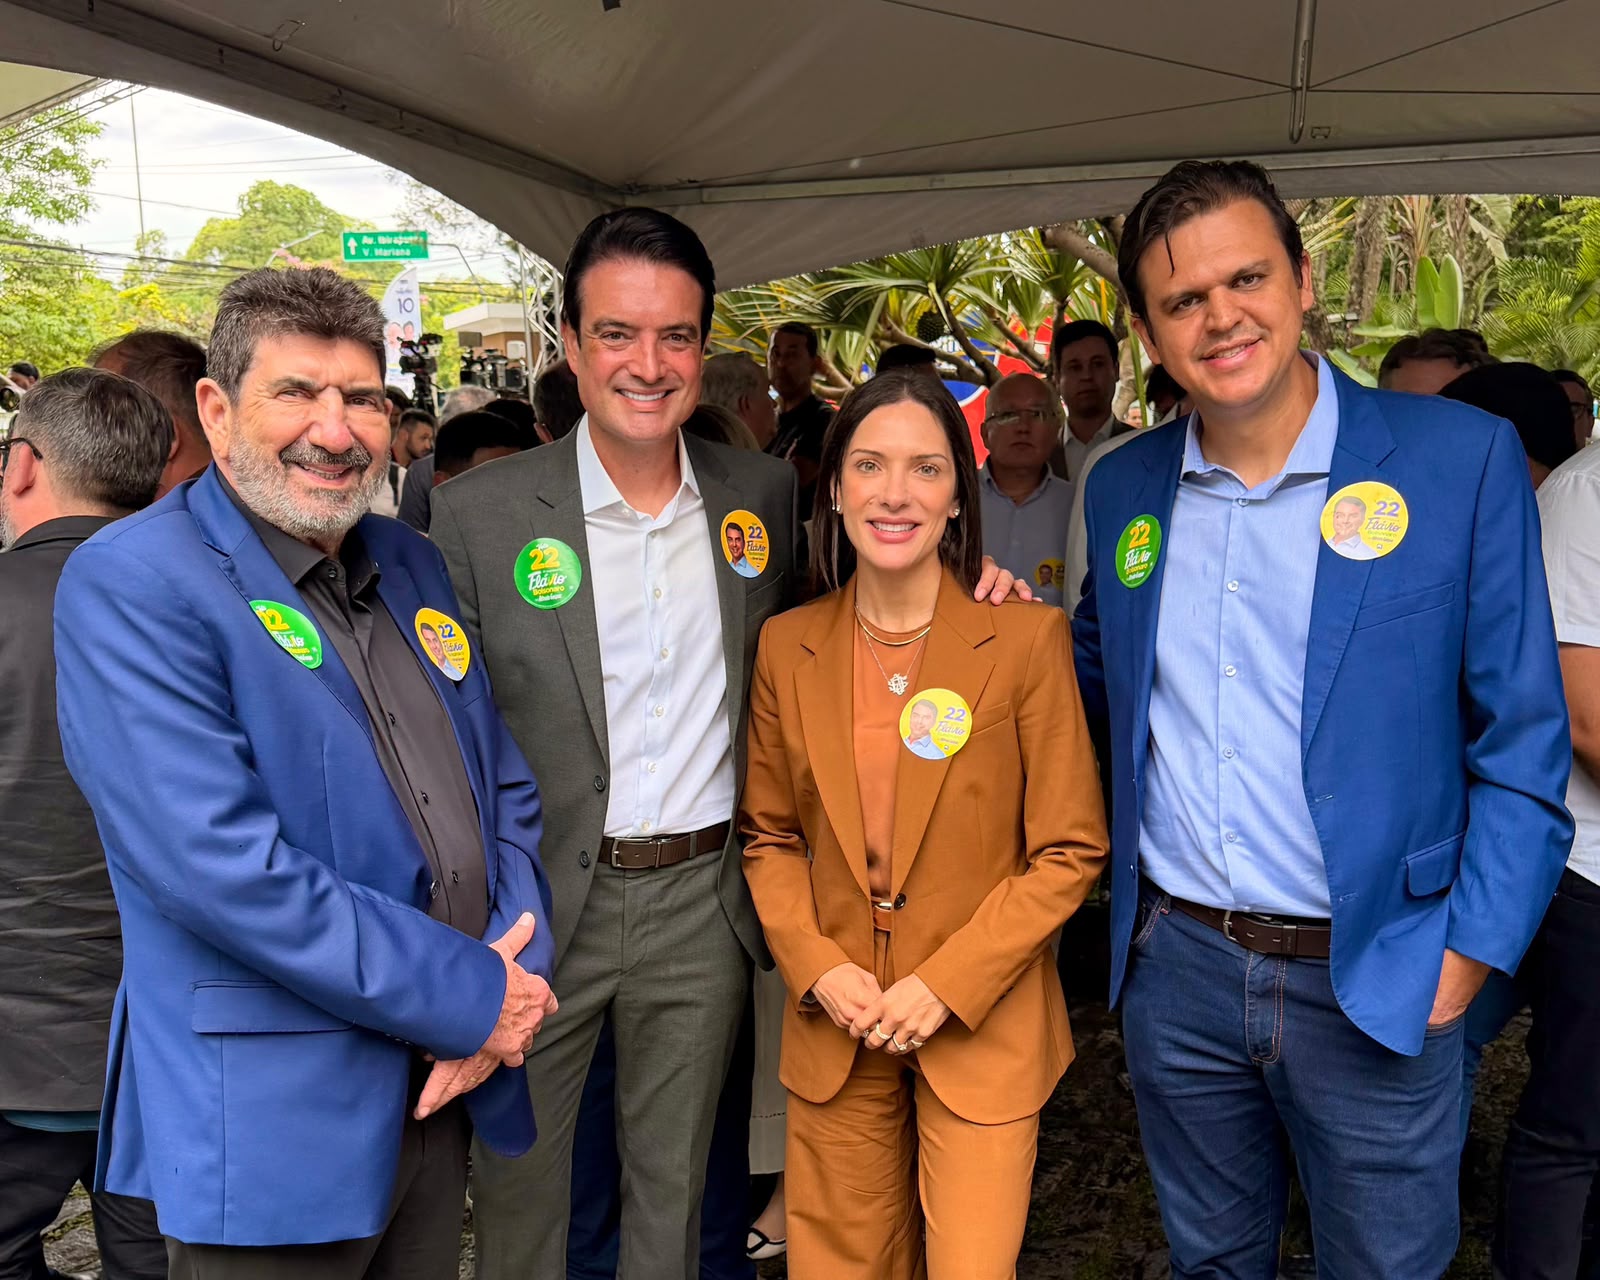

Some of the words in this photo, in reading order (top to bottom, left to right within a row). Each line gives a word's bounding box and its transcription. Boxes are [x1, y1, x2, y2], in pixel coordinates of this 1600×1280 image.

[398, 298, 414, 313] 10
[1374, 500, 1400, 517] 22
[1365, 517, 1401, 532] Flávio
[748, 526, 763, 539] 22
[1129, 523, 1150, 548] 22
[746, 540, 766, 551] Flávio
[529, 547, 560, 571] 22
[1124, 549, 1152, 570] Flávio
[528, 571, 567, 591] Flávio
[532, 585, 565, 596] Bolsonaro
[438, 624, 456, 639] 22
[442, 640, 464, 651] Flávio
[944, 707, 966, 722] 22
